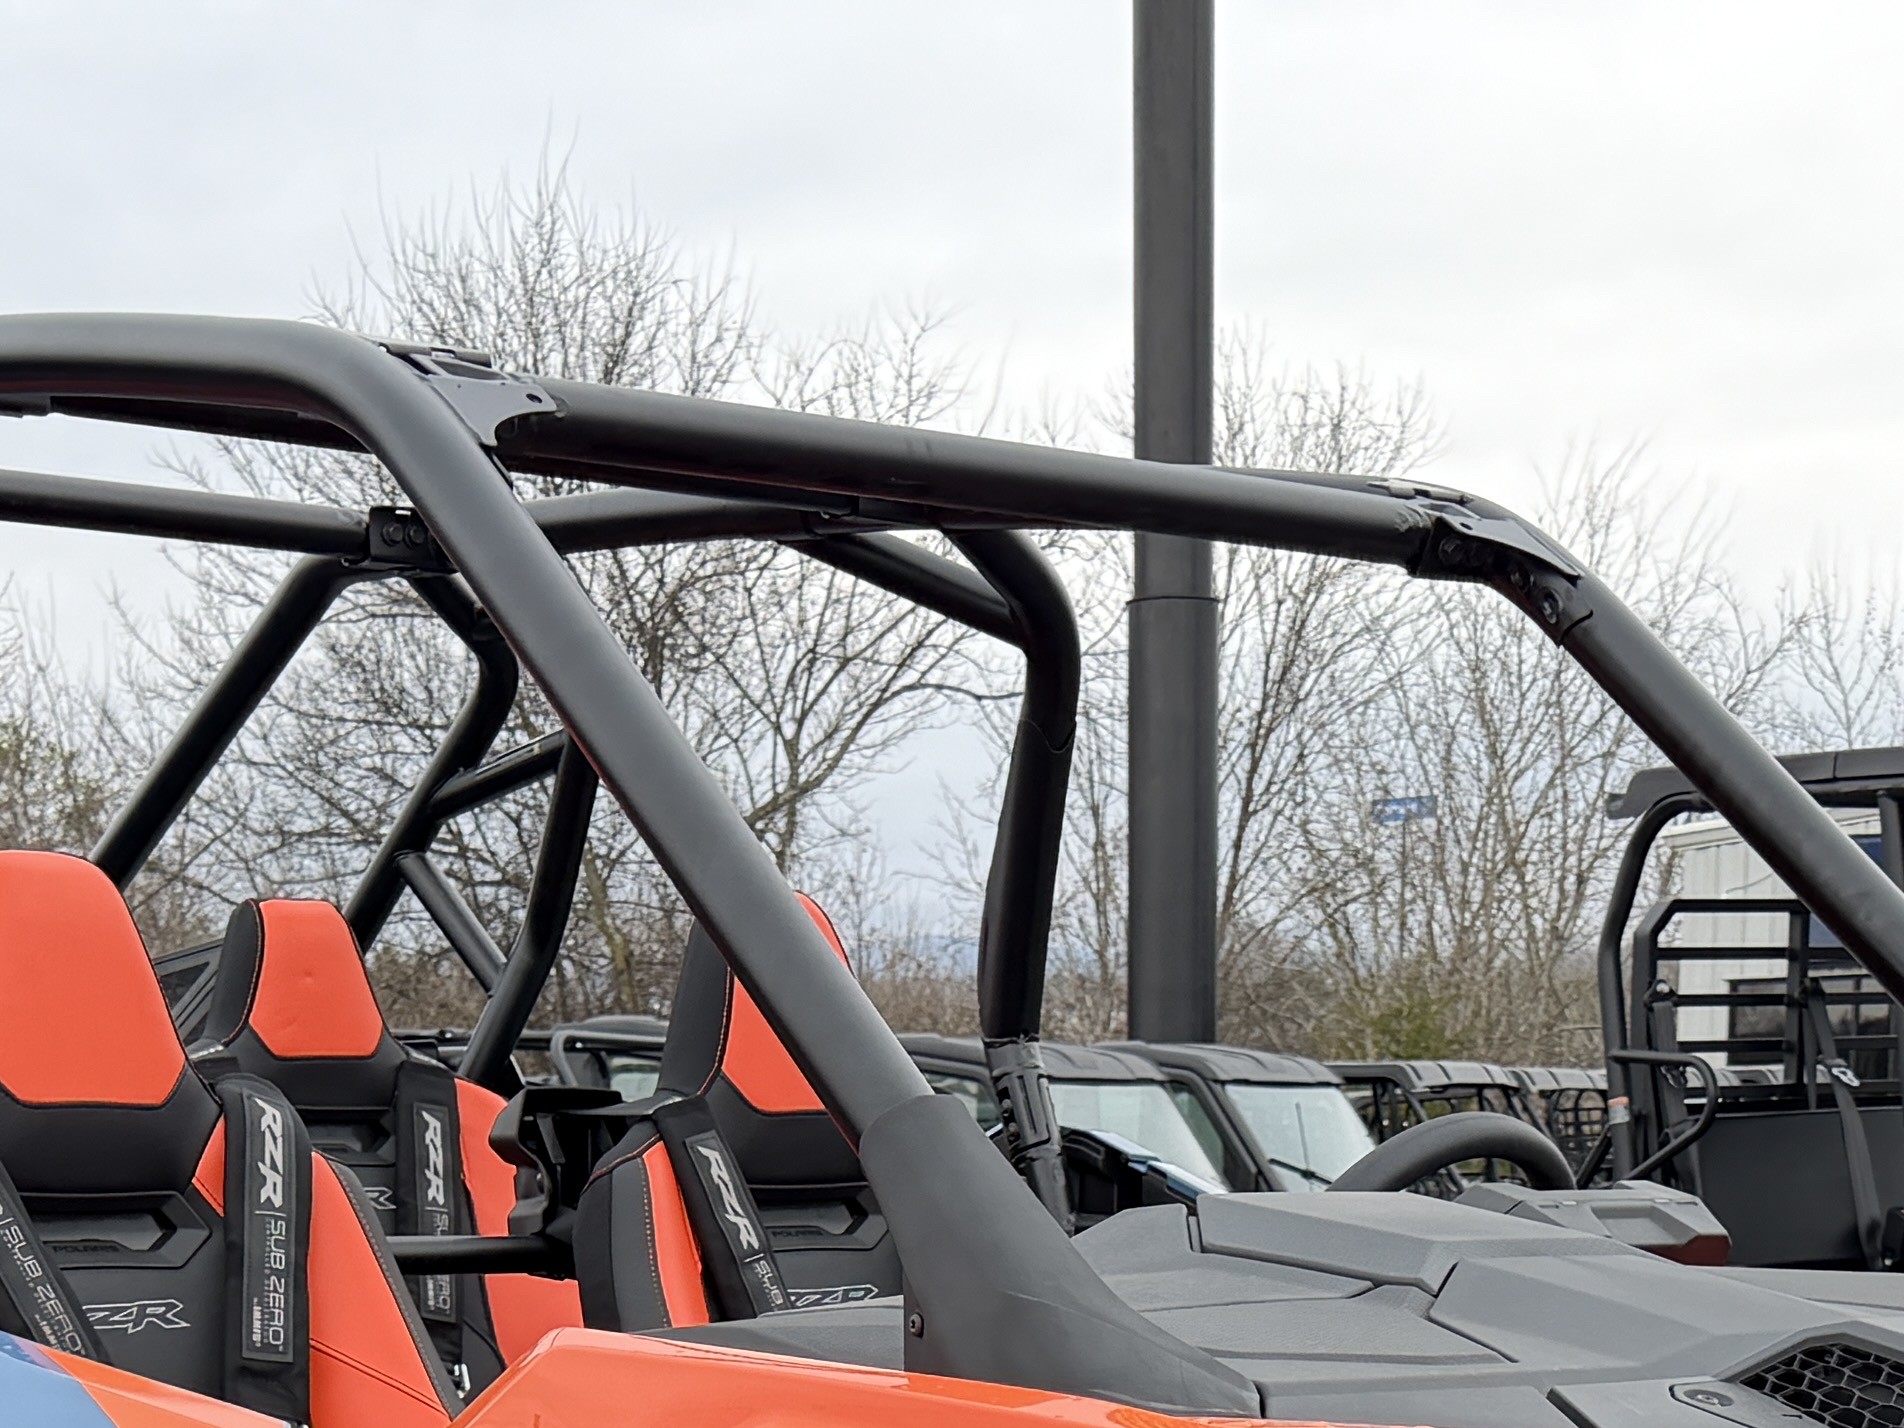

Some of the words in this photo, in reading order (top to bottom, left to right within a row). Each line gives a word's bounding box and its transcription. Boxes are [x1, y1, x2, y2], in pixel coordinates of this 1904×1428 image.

[254, 1097, 284, 1208] RZR
[421, 1110, 445, 1206] RZR
[696, 1145, 760, 1251] RZR
